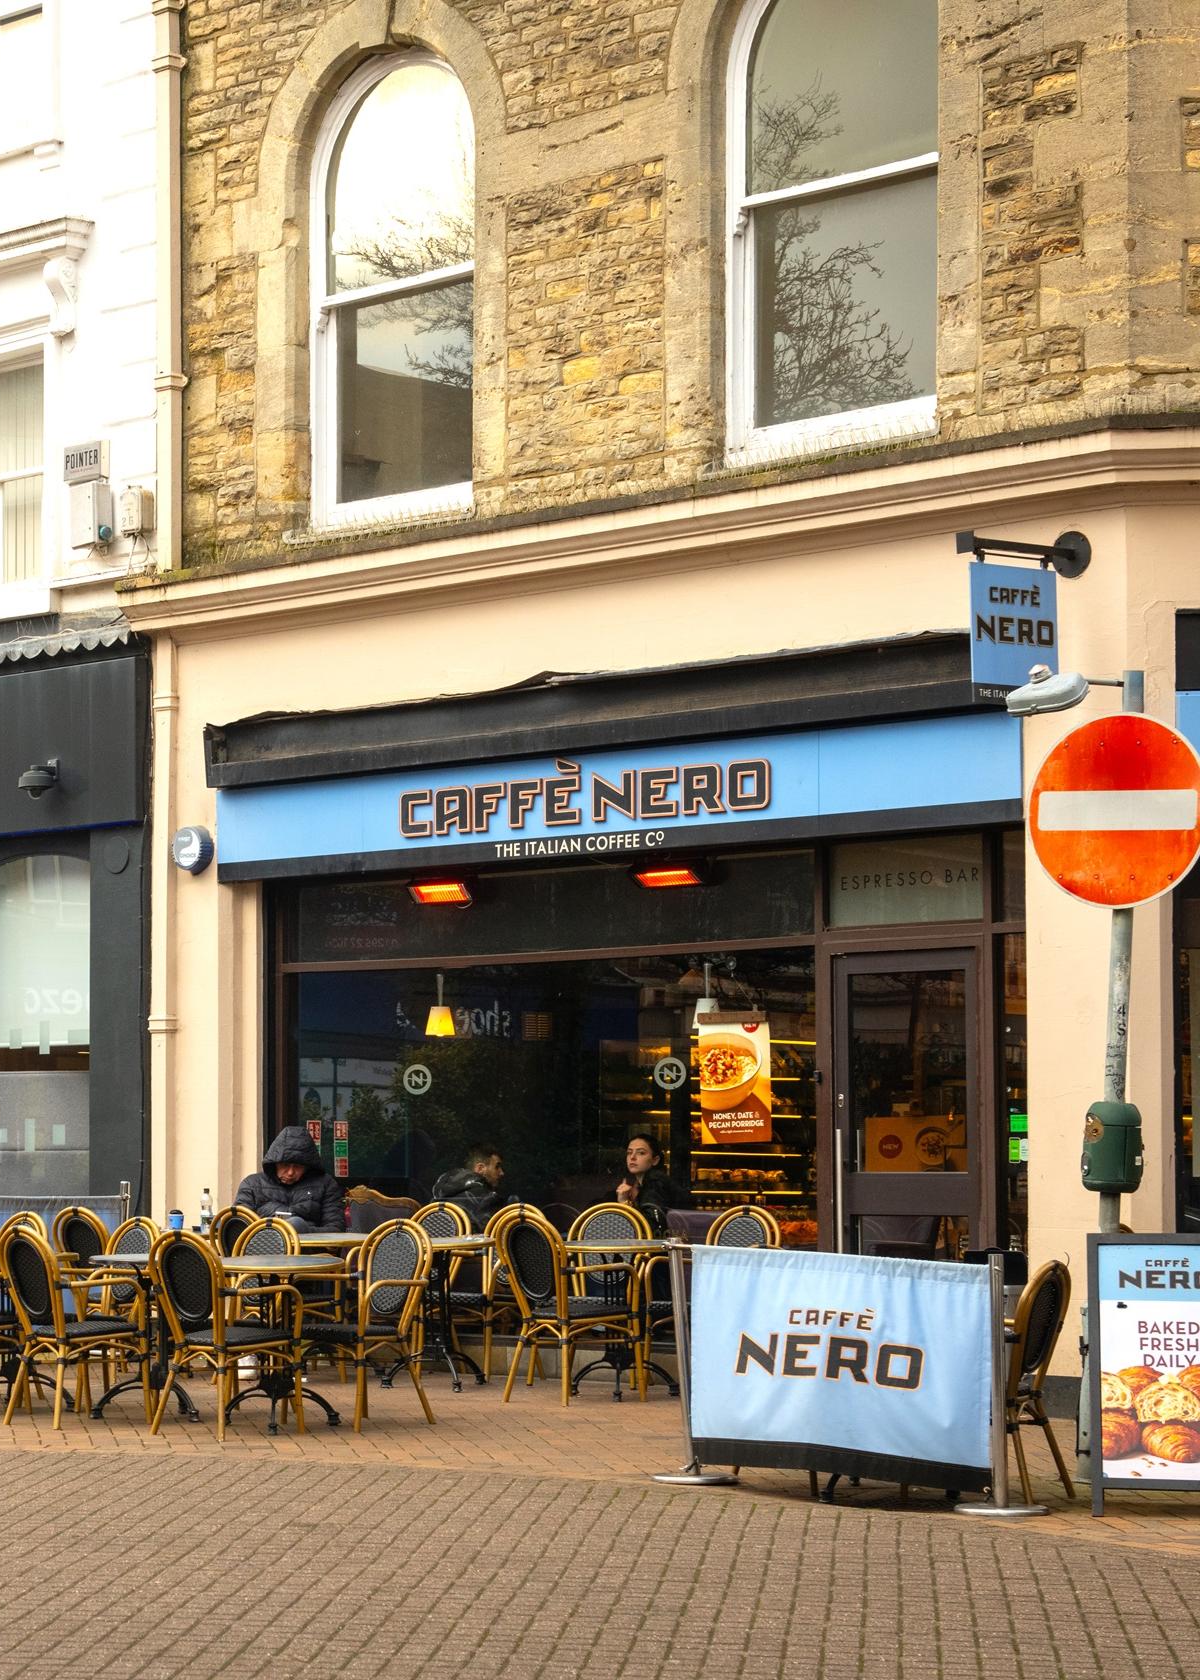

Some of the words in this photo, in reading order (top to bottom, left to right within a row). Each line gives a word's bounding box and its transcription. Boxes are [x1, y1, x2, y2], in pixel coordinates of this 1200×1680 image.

[65, 448, 99, 471] POINTER
[989, 583, 1041, 609] CAFFÈ
[975, 613, 1055, 649] NERO
[978, 688, 992, 698] THE
[398, 757, 582, 838] CAFFÈ
[591, 757, 772, 822] NERO
[494, 842, 521, 858] THE
[524, 837, 581, 857] ITALIAN
[585, 833, 640, 851] COFFEE
[840, 870, 933, 891] ESPRESSO
[944, 867, 979, 884] BAR
[708, 1121, 731, 1129] PECAN
[731, 1119, 764, 1128] PORRIDGE
[712, 1112, 737, 1120] HONEY,
[737, 1111, 754, 1119] DATE
[754, 1111, 760, 1119] &
[882, 1143, 899, 1151] NEW
[1145, 1257, 1190, 1268] CAFFÈ
[787, 1308, 875, 1332] CAFFÈ
[1137, 1320, 1200, 1335] BAKED
[1139, 1337, 1200, 1352] FRESH
[734, 1331, 926, 1392] NERO
[1143, 1353, 1197, 1369] DAILY
